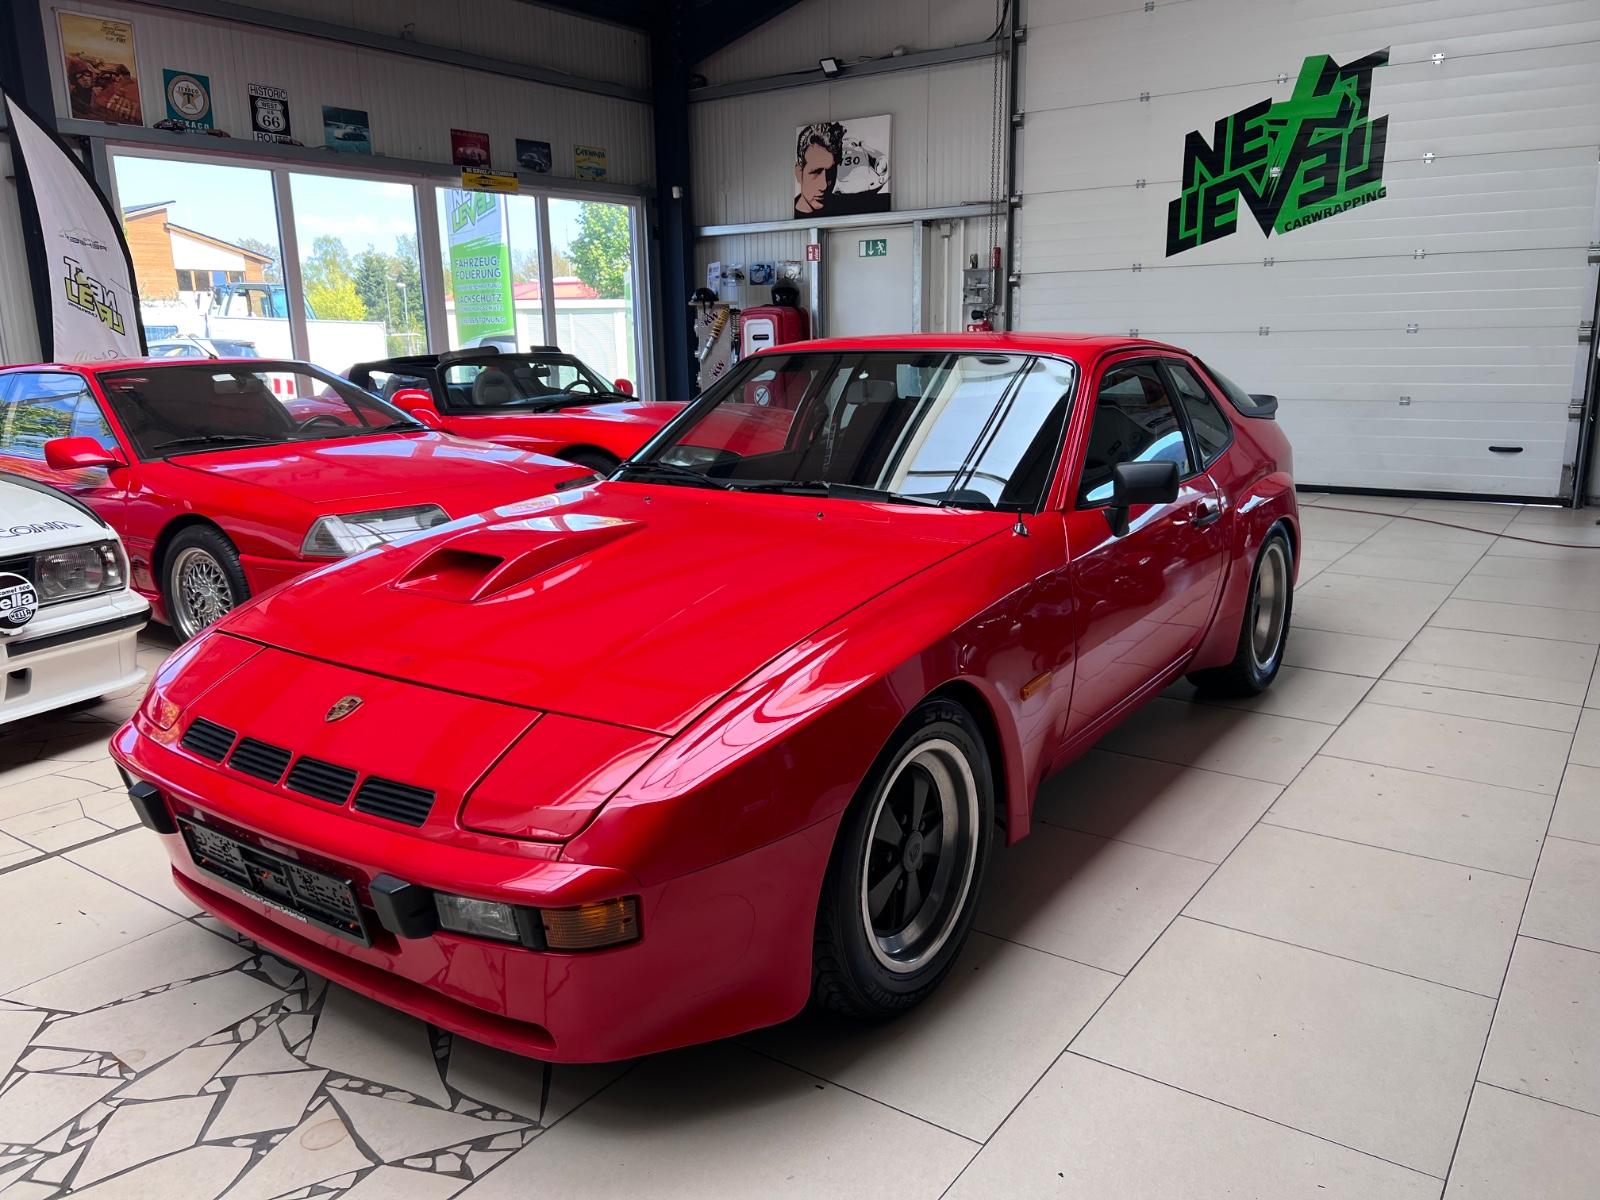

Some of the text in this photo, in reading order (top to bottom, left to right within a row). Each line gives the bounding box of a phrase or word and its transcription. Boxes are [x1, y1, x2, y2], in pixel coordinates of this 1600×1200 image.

[250, 84, 287, 99] HISTORIC
[262, 114, 281, 129] 66
[1165, 113, 1390, 258] LEVEL
[1284, 186, 1388, 233] CARWRAPPING
